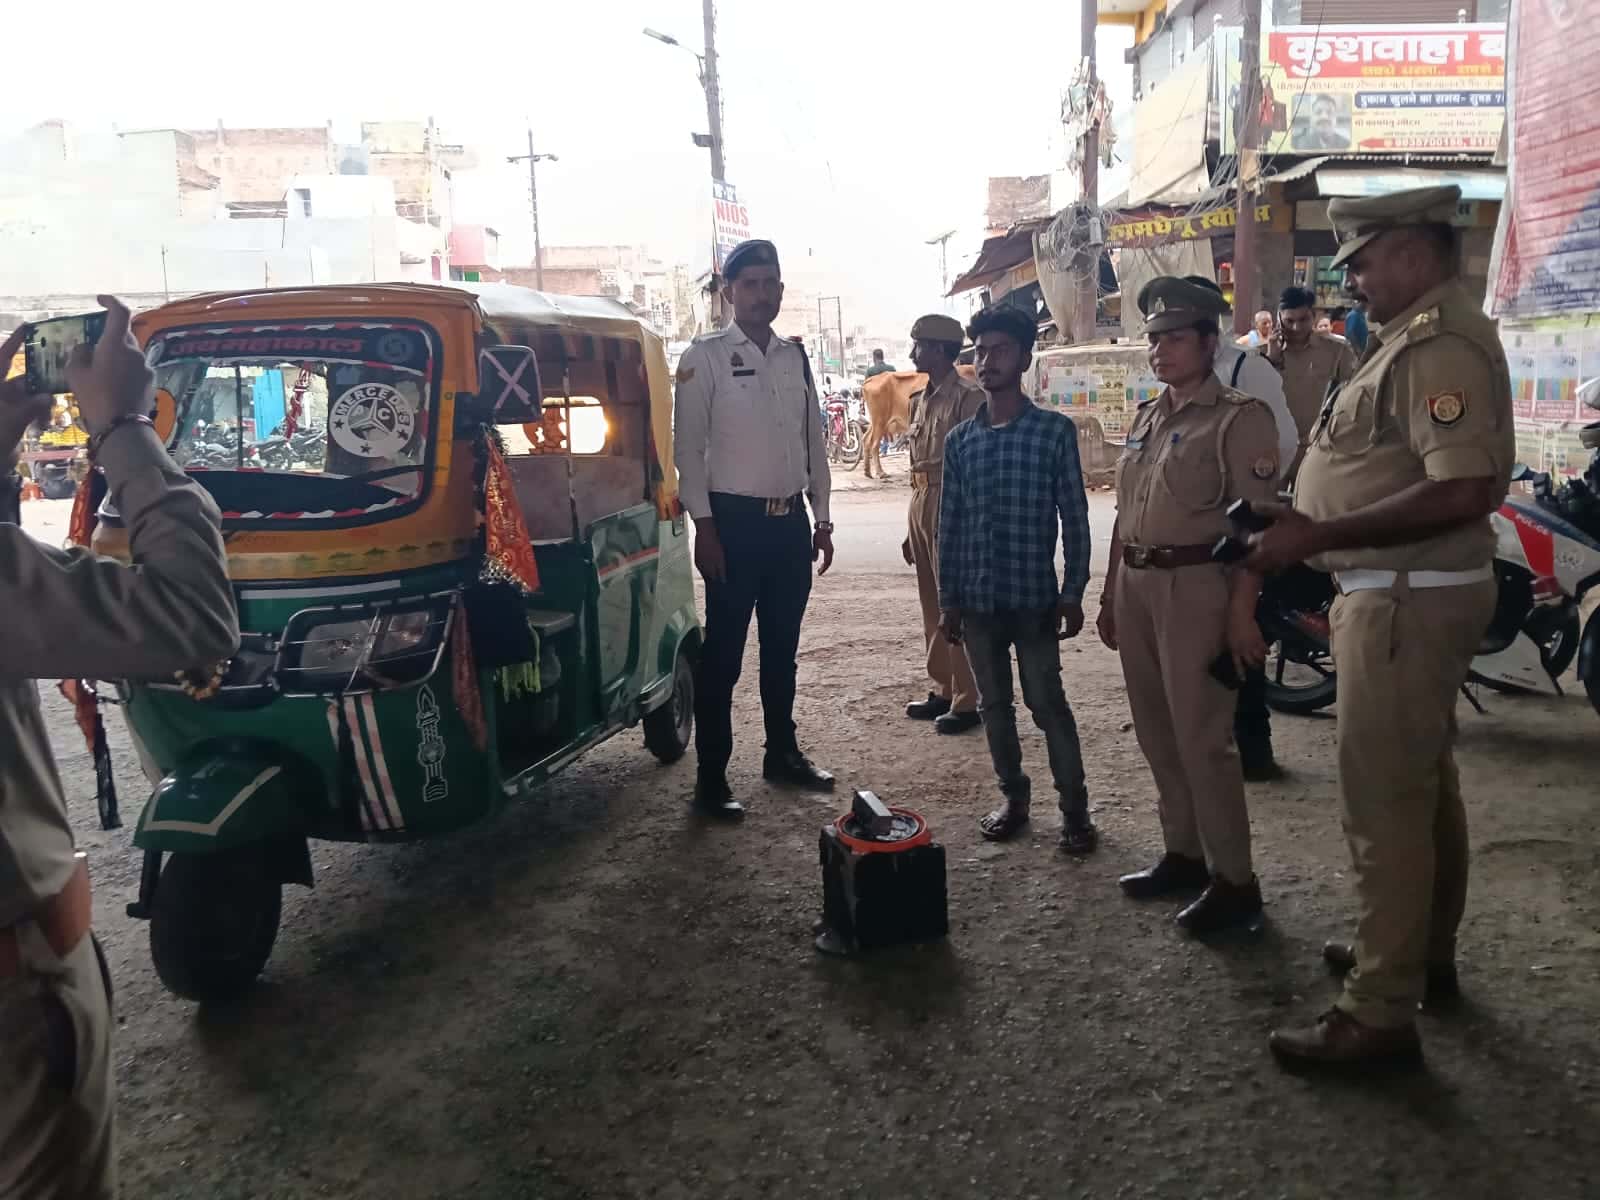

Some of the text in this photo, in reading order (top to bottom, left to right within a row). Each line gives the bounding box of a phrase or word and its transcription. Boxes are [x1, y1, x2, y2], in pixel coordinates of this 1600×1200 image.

[1286, 35, 1468, 77] कुशवाहा
[715, 200, 750, 226] NIOS
[1515, 512, 1550, 536] POLICE
